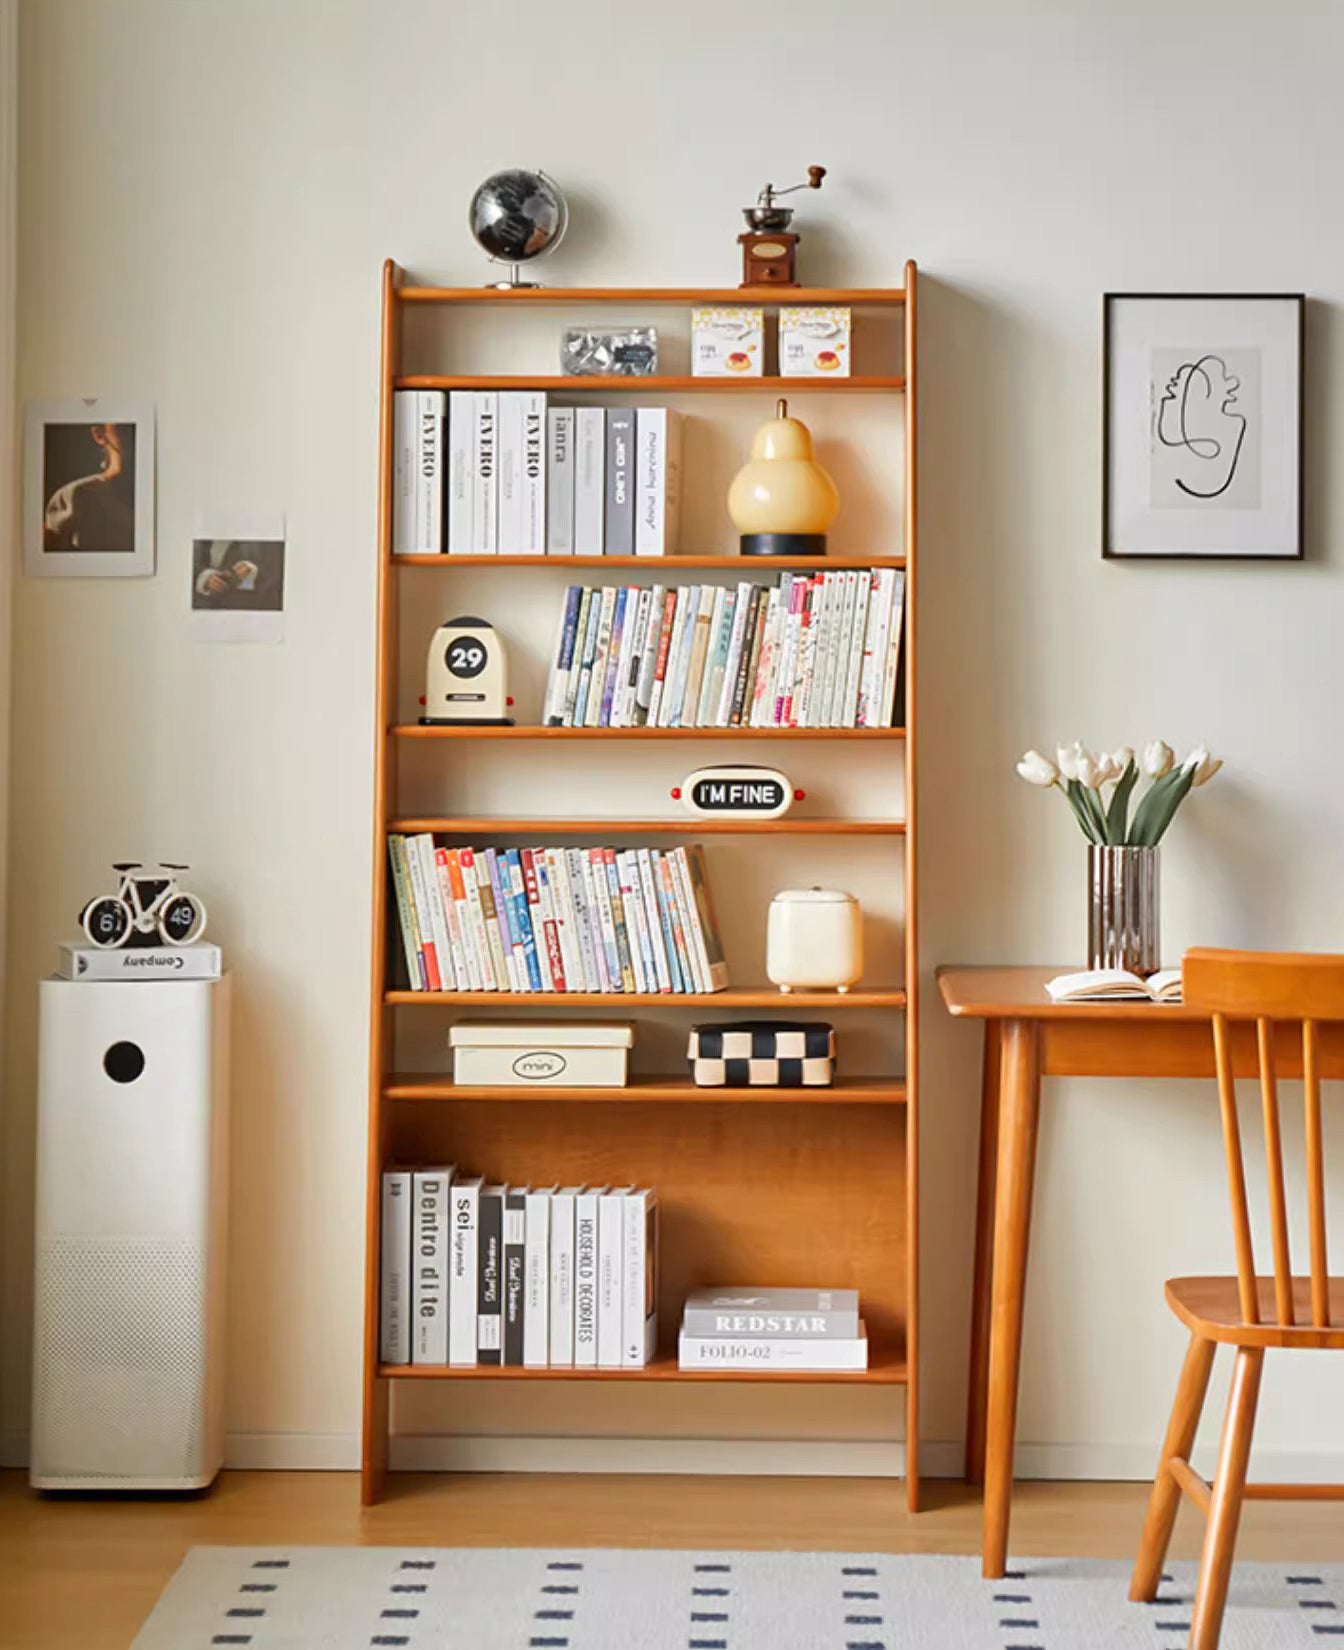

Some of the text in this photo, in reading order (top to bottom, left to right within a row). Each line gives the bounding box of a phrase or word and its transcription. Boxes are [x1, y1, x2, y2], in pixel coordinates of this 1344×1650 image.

[451, 647, 483, 668] 29
[700, 784, 775, 803] I'M FINE
[169, 906, 192, 925] 49
[123, 956, 184, 969] Company
[522, 1058, 556, 1071] mini
[456, 1198, 474, 1231] sei
[420, 1180, 440, 1318] Dentro di te
[579, 1218, 593, 1343] HOUSEHOLD DECORATES
[716, 1315, 827, 1332] REDSTAR
[700, 1345, 771, 1359] FOLIO-02
